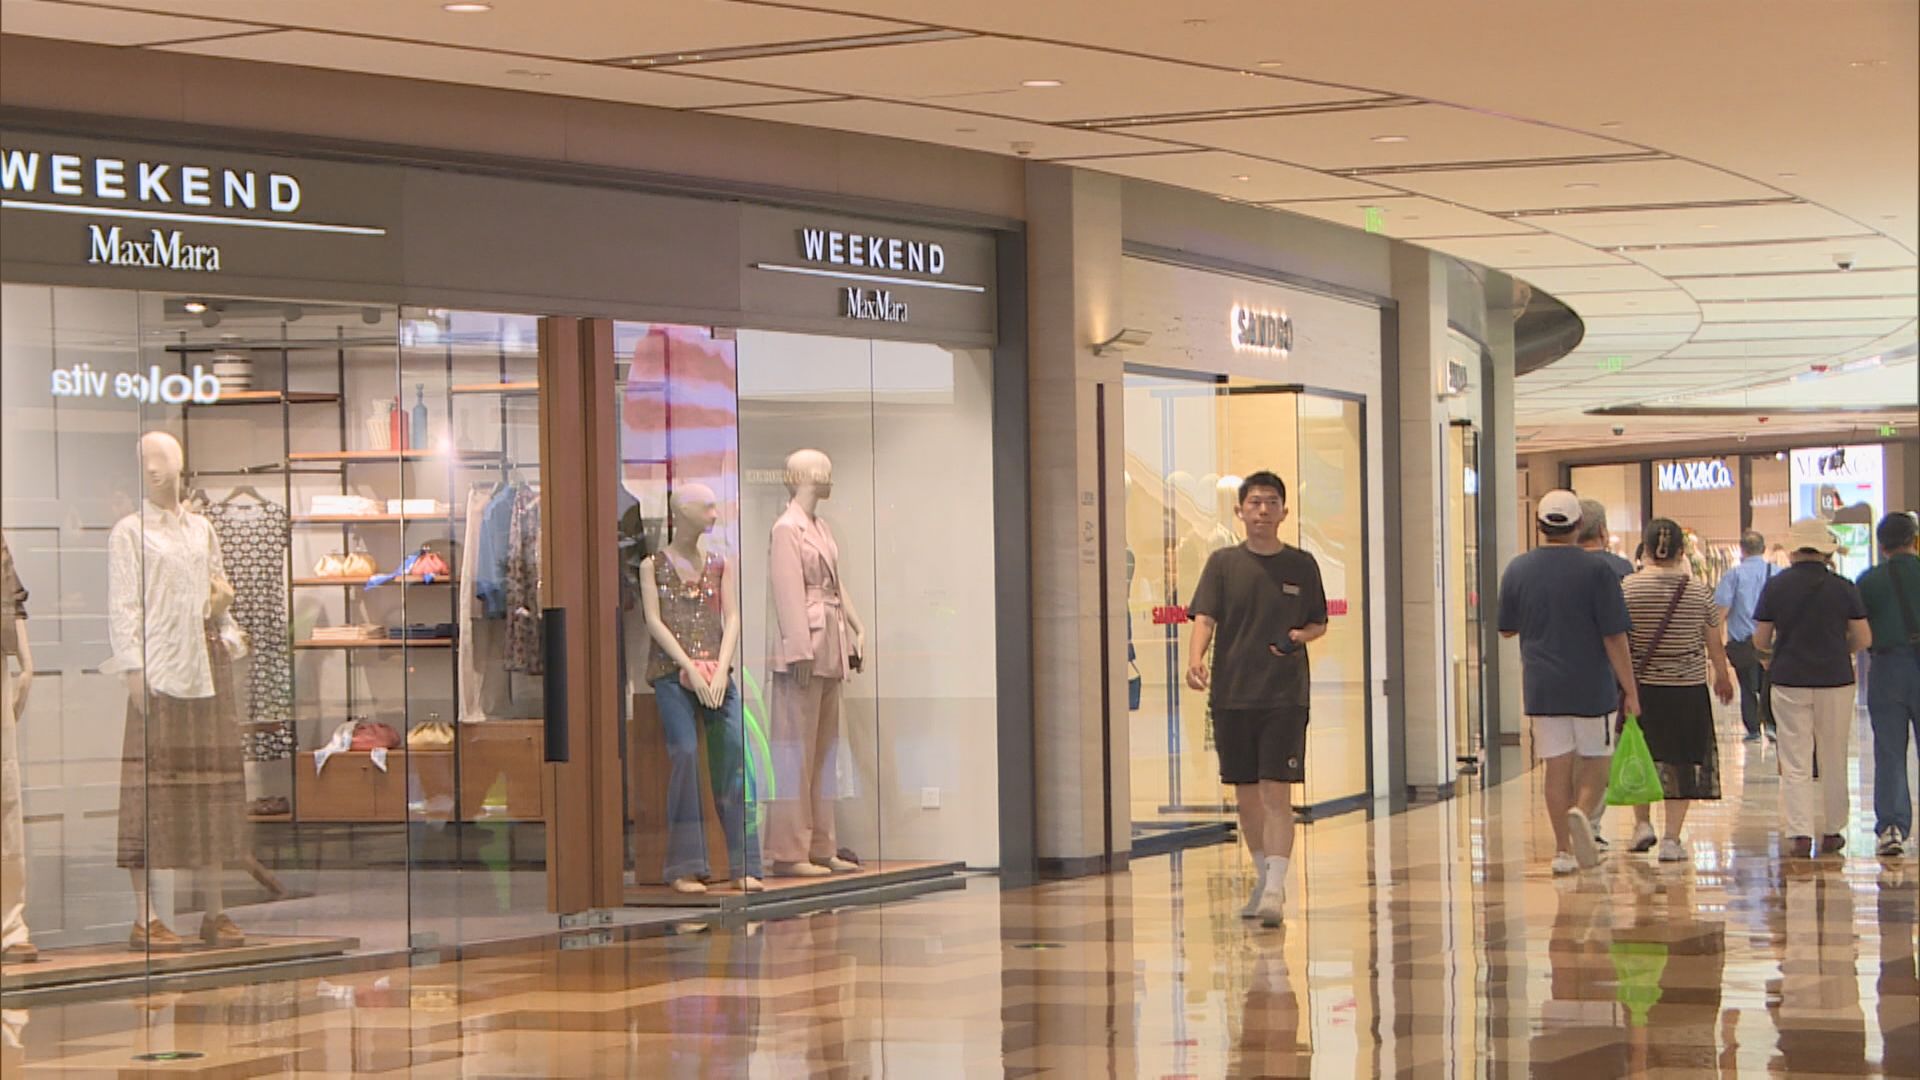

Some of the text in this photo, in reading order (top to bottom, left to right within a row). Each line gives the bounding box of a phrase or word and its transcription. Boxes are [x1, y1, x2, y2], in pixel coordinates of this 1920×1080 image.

[0, 150, 300, 213] WEEKEND
[89, 224, 221, 273] MaxMara
[803, 227, 945, 275] WEEKEND
[847, 286, 909, 323] MaxMara
[1237, 306, 1294, 352] SANDRO
